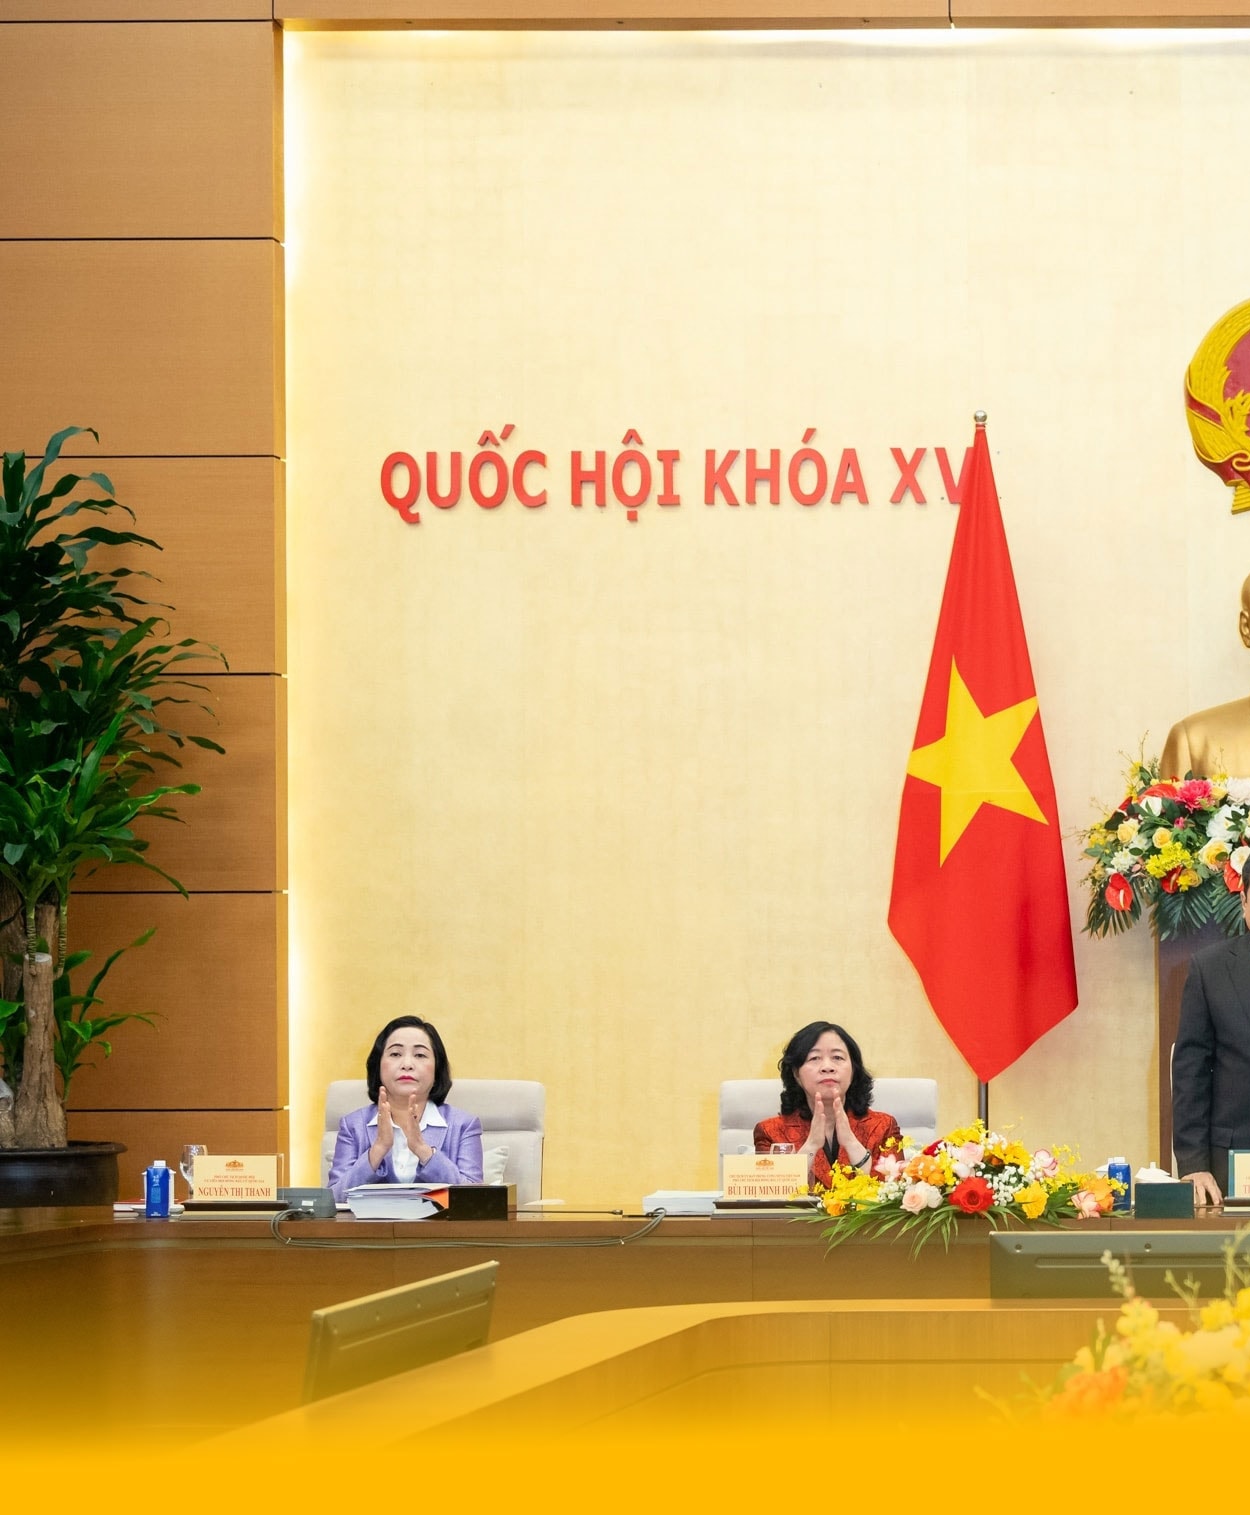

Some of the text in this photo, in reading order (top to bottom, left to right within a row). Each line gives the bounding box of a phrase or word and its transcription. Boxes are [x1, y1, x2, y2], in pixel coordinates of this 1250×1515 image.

[380, 424, 548, 524] QUỐC
[571, 428, 681, 522] HỘI
[704, 428, 869, 506] KHÓA
[245, 1187, 271, 1197] THANH
[760, 1185, 780, 1195] MINH
